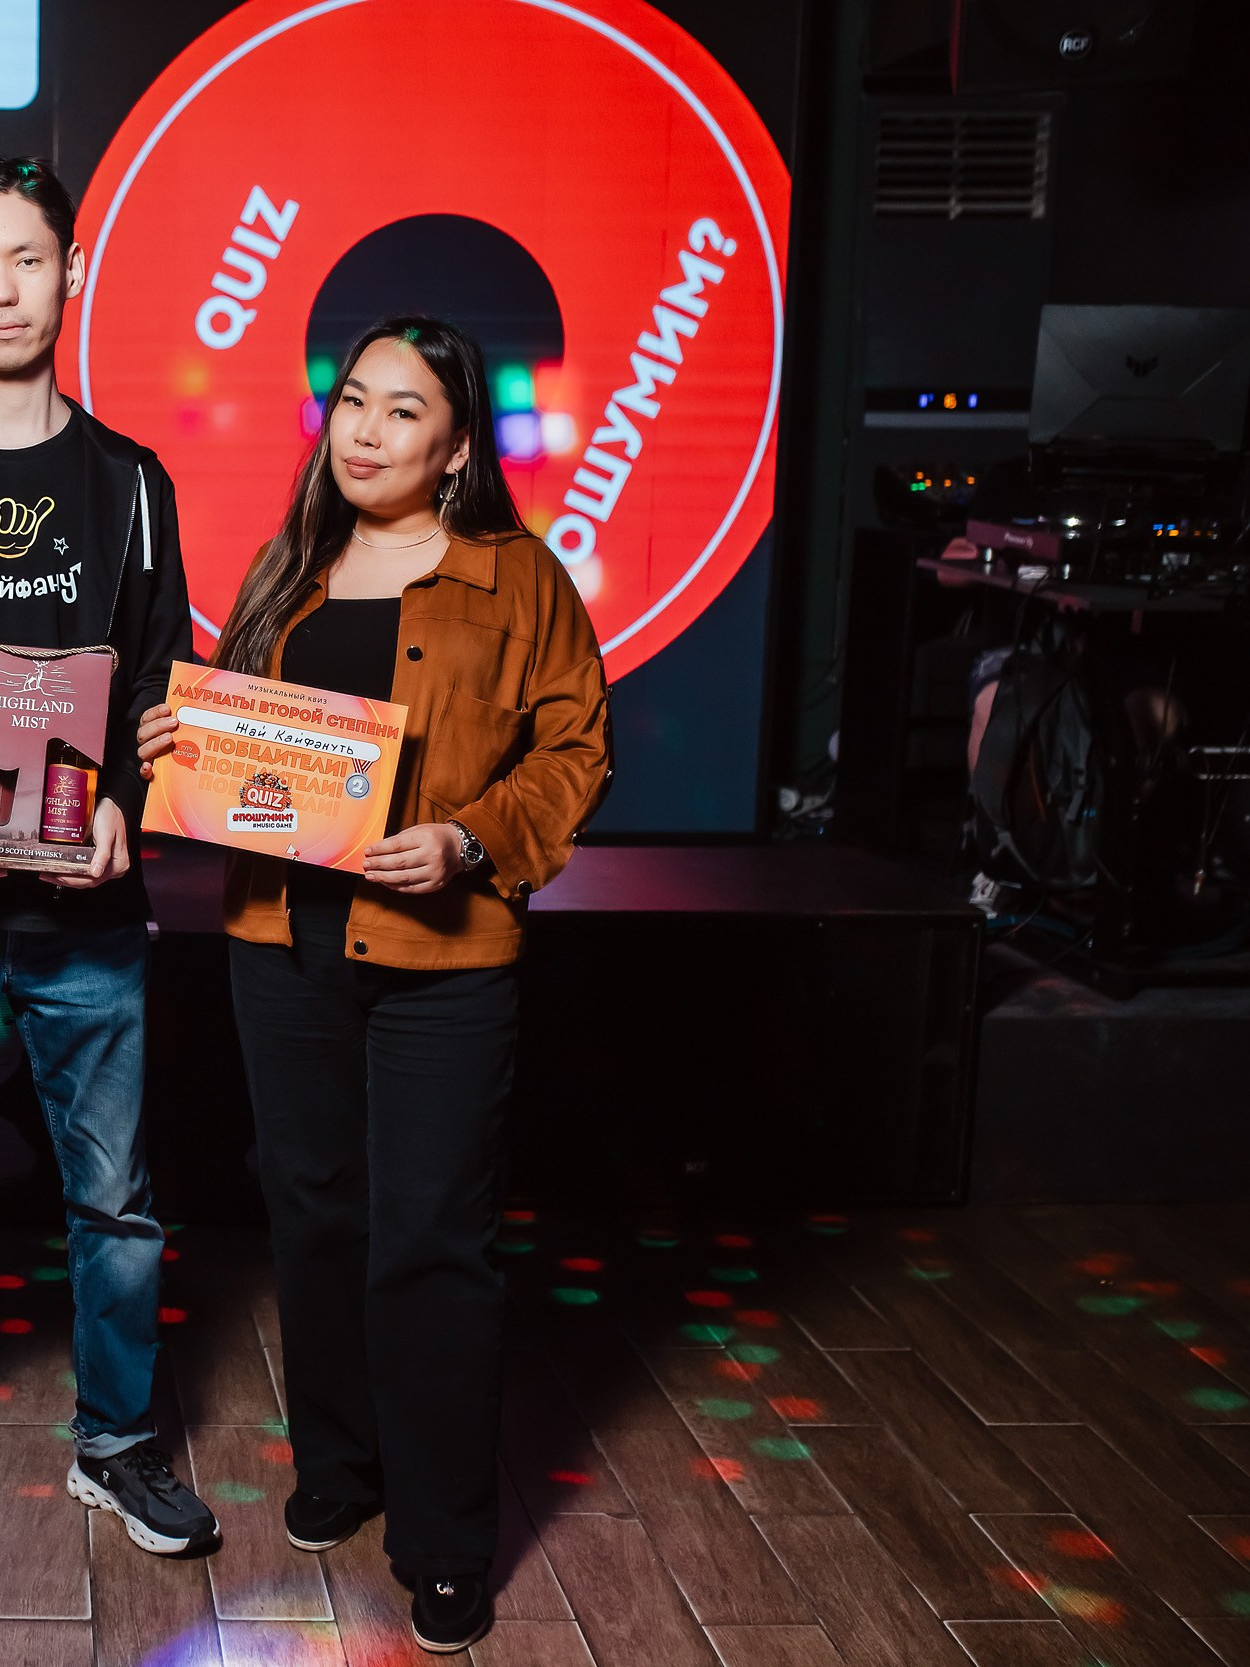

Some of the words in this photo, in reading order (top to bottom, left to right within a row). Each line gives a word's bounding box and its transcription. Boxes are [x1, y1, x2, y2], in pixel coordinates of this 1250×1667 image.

[195, 184, 300, 350] QUIZ
[545, 217, 737, 567] ОШУМИМ?
[248, 684, 305, 700] МУЗЫКАЛЬНЫЙ
[307, 696, 328, 705] КВИЗ
[11, 714, 50, 730] MIST
[172, 684, 256, 712] ЛАУРЕАТЫ
[258, 701, 324, 725] ВТОРОЙ
[327, 715, 400, 740] СТЕПЕНИ
[205, 734, 348, 778] ПОБЕДИТЕЛИ!
[352, 778, 364, 793] 2
[45, 797, 80, 807] GHLAND
[247, 787, 284, 808] QUIZ
[232, 813, 294, 822] #ПОШУМИМ?
[5, 847, 33, 856] SCOTCH
[35, 850, 63, 859] WHISKY
